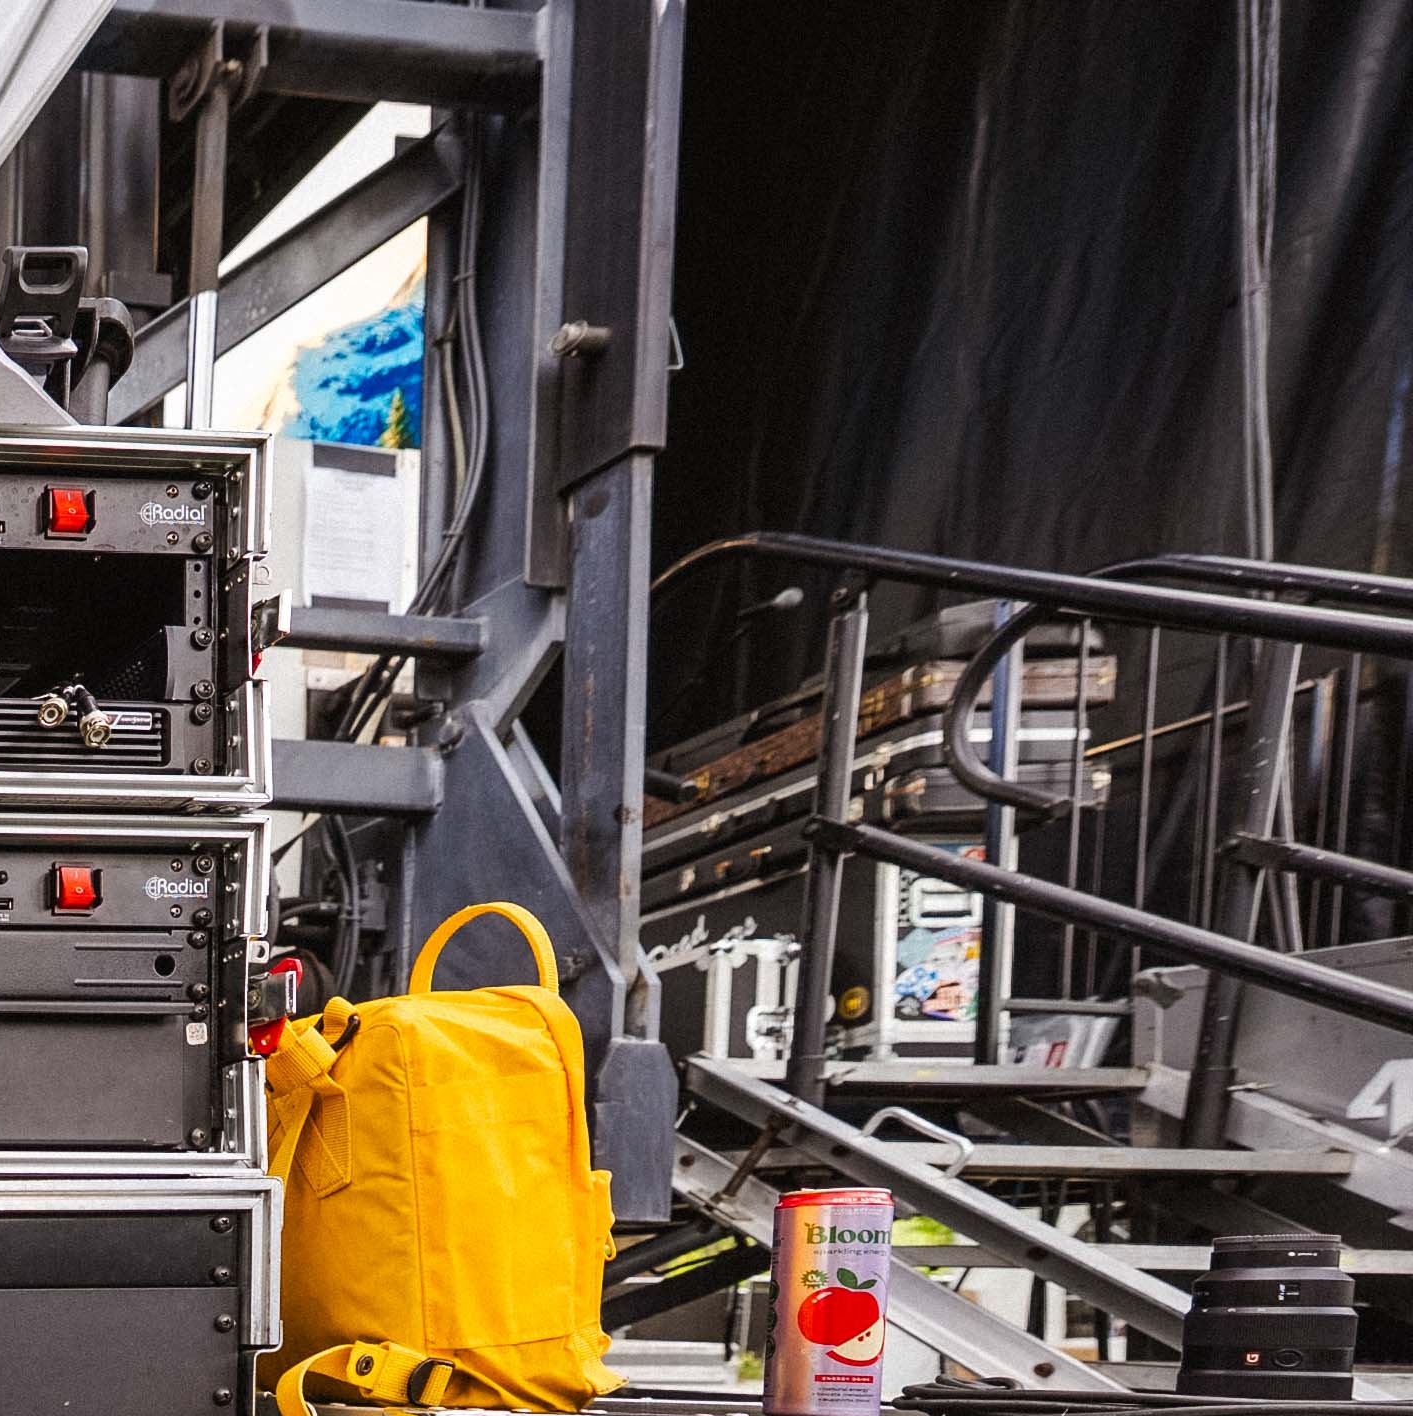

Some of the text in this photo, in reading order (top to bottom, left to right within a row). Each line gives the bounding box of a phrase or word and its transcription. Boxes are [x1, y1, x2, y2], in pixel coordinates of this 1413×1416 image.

[153, 505, 206, 520] Radial
[158, 878, 208, 894] Radial
[806, 1223, 891, 1244] Bloom
